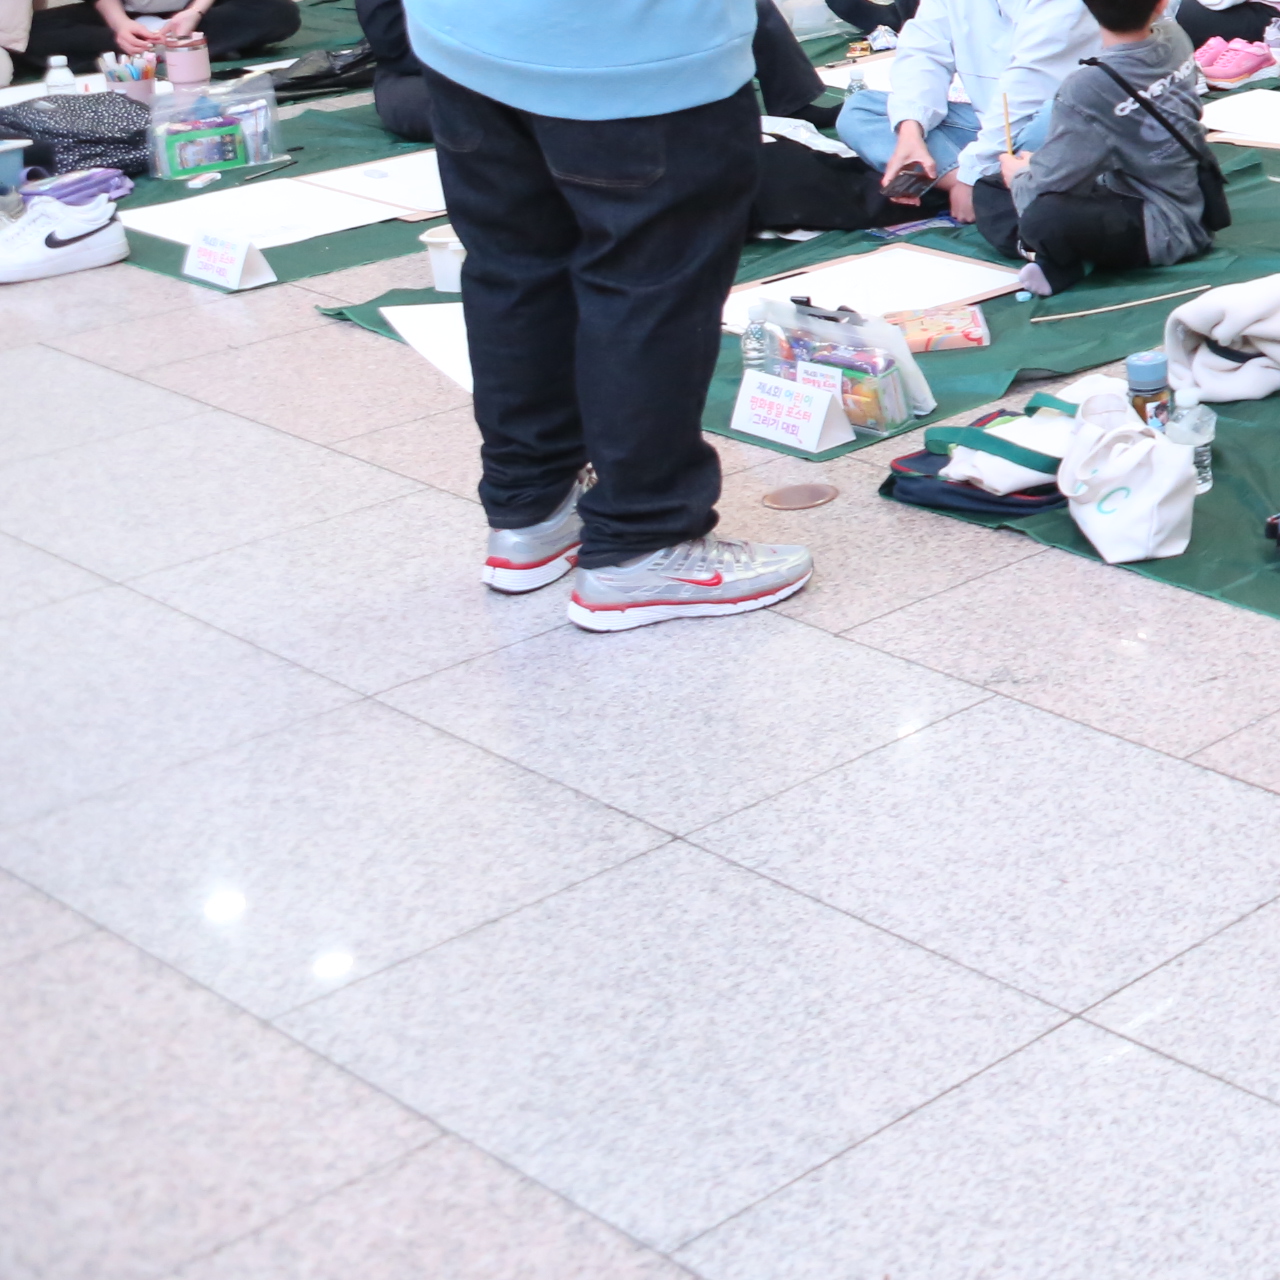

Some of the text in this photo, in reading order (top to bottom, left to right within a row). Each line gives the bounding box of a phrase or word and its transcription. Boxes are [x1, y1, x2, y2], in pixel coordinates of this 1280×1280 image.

[756, 381, 813, 408] 제4회 어린이
[750, 395, 812, 423] 평화통일 포스터
[752, 413, 800, 436] 그리기 대회
